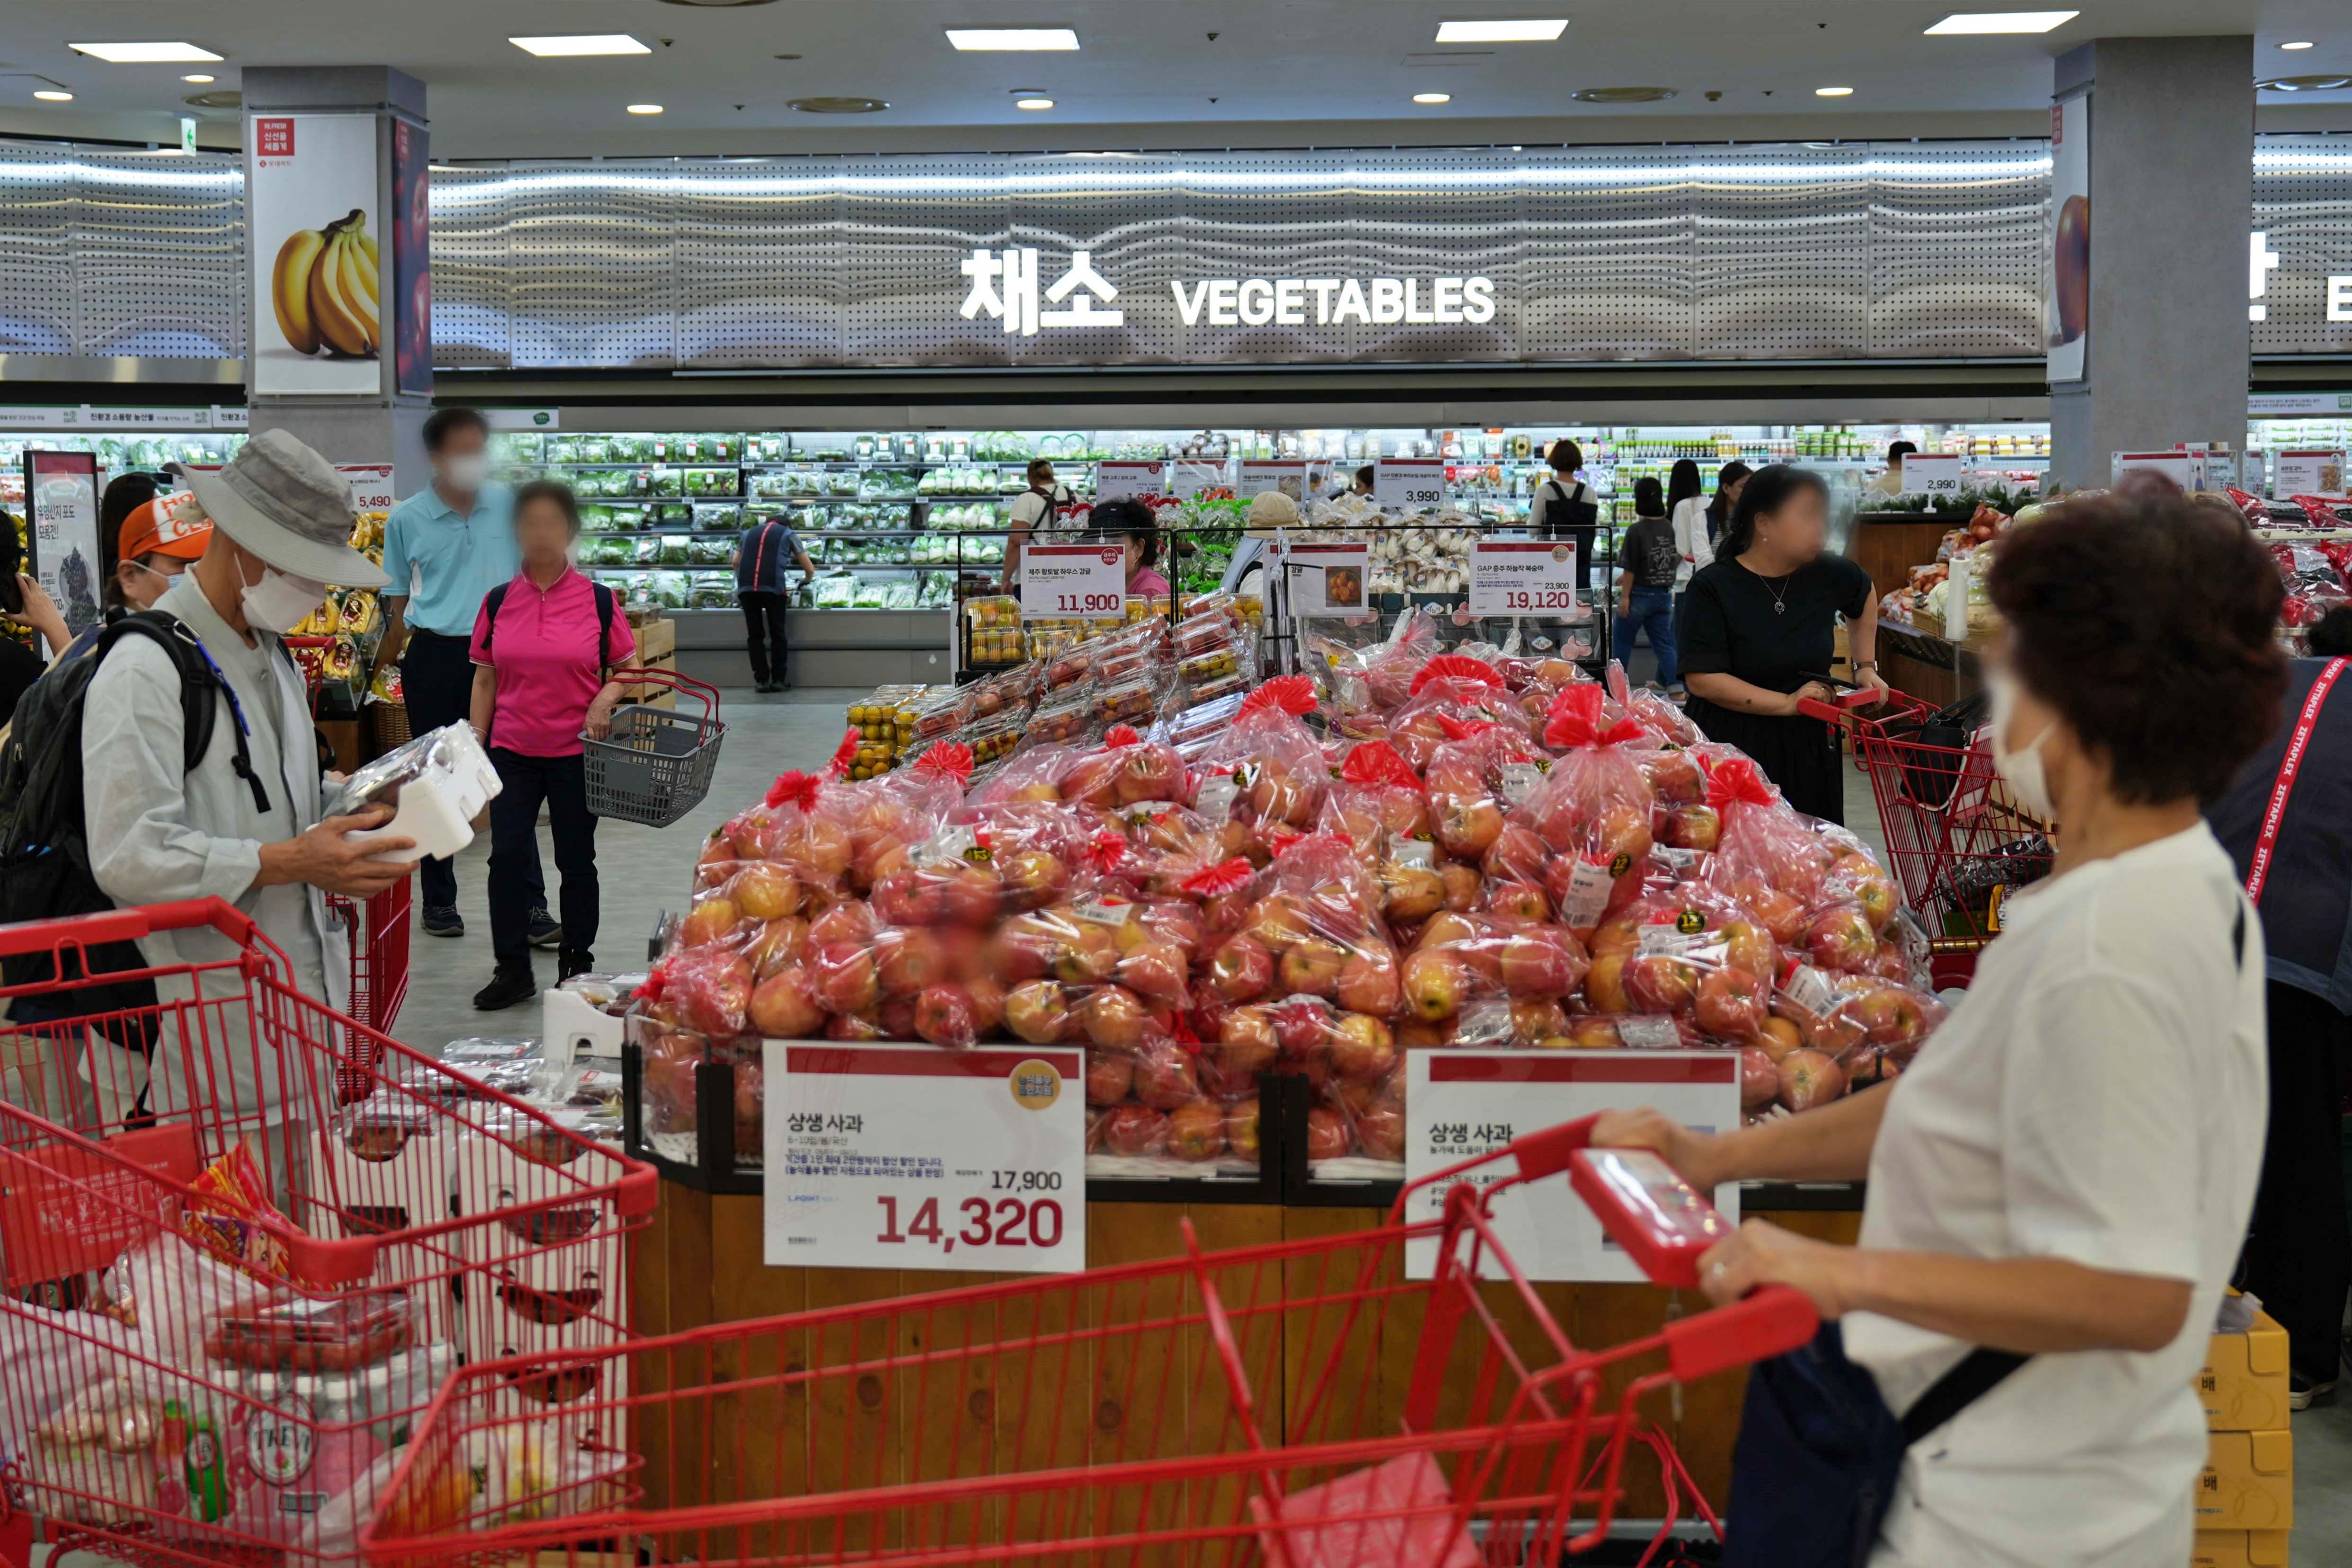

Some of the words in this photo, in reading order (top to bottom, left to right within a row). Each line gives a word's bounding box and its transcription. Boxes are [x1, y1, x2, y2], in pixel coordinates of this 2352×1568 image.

[264, 132, 287, 141] 신선을
[264, 142, 287, 151] 새롭게
[960, 248, 1124, 336] 채소
[1171, 276, 1496, 326] VEGETABLES
[90, 413, 110, 421] 친환경
[134, 413, 154, 421] 농산물
[221, 413, 239, 421] 친환경
[1928, 479, 1956, 491] 2,990
[359, 496, 390, 508] 5,490
[1406, 490, 1440, 503] 3,990
[38, 504, 62, 520] 유명산지
[62, 505, 75, 518] 포도
[39, 524, 59, 540] 모음전!
[1545, 582, 1569, 590] 23,900
[1058, 594, 1119, 613] 11,900
[1507, 592, 1570, 611] 19,120
[2304, 682, 2327, 719] ZETTAPLEX
[2283, 726, 2308, 776] ZETTAPLEX
[2264, 784, 2286, 838] ZETTAPLEX
[2248, 847, 2268, 899] ZETTAPLEX
[787, 1112, 823, 1133] 상생
[826, 1113, 865, 1134] 사과
[1429, 1123, 1468, 1143] 상생
[1473, 1123, 1513, 1143] 사과
[1429, 1145, 1455, 1154] 농가에
[1457, 1145, 1482, 1155] 도움이
[825, 1154, 841, 1164] 최대
[991, 1170, 1061, 1193] 17,900
[877, 1195, 1063, 1253] 14,320
[2202, 1375, 2216, 1392] 배
[2203, 1475, 2218, 1491] 배
